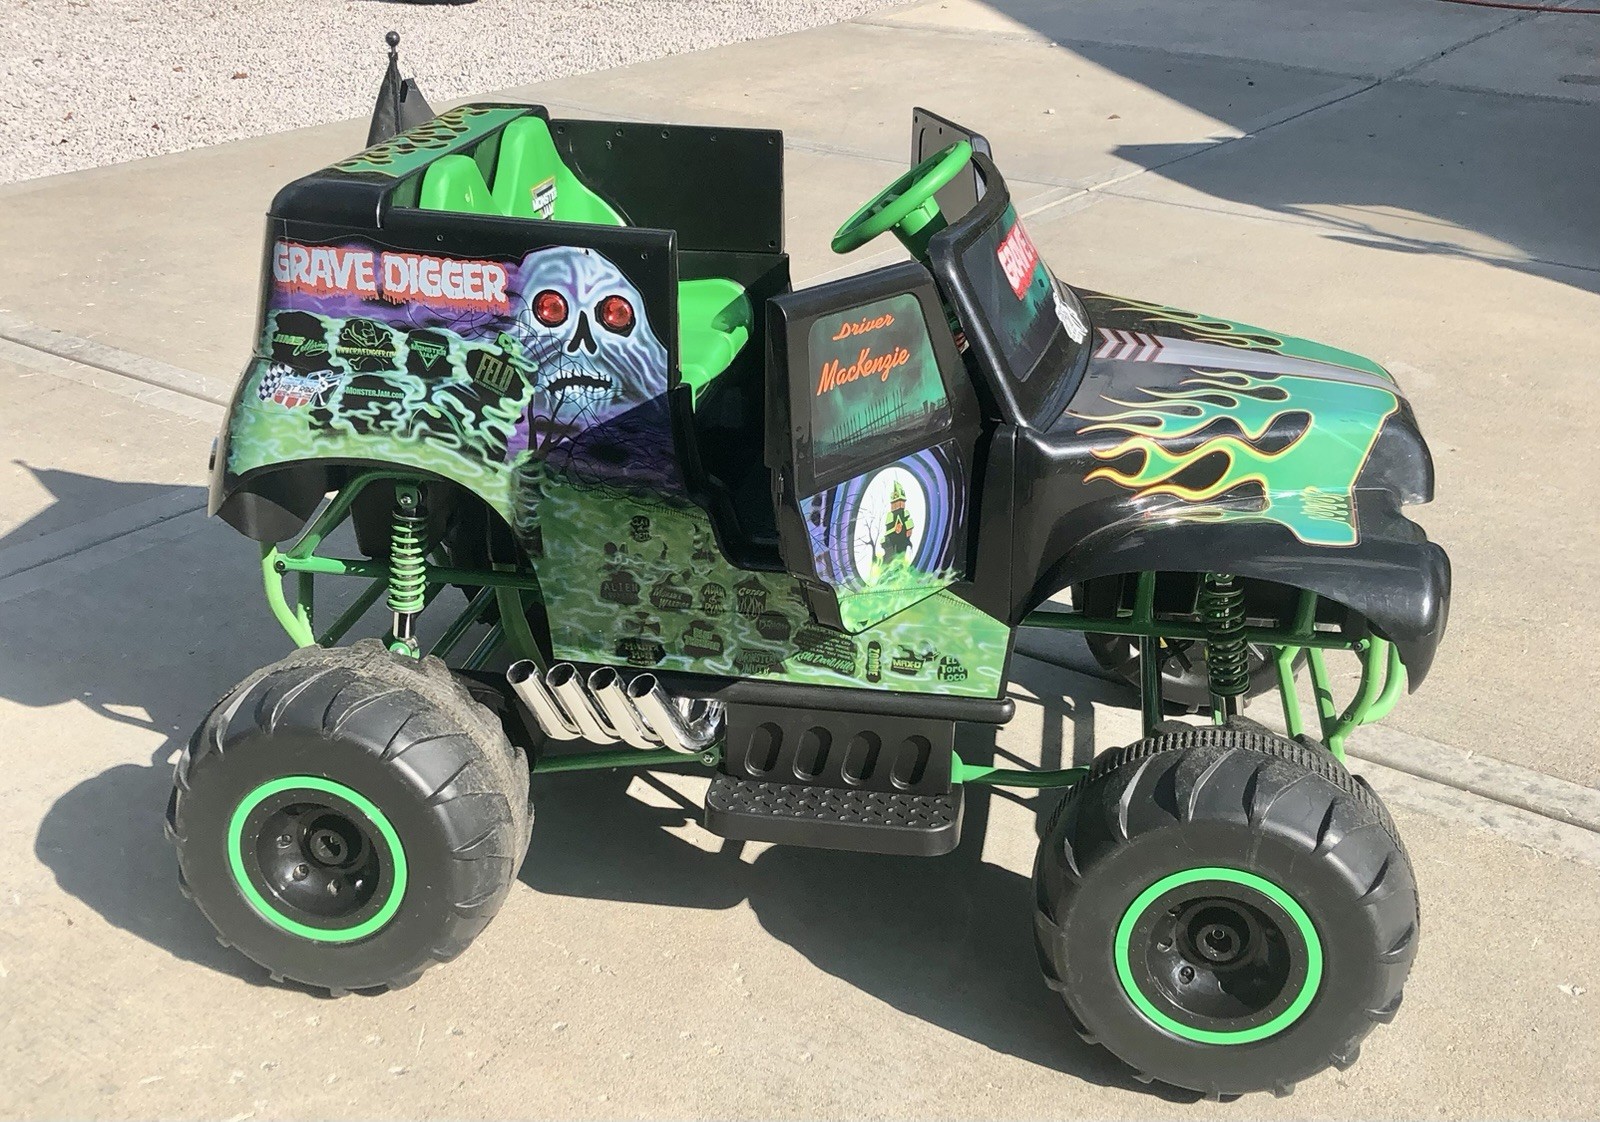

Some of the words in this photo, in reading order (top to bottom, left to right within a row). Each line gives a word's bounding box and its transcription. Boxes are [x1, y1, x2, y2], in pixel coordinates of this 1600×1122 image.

[273, 242, 375, 291] GRAVE
[384, 254, 507, 302] DIGGER
[832, 312, 895, 341] Driver
[474, 353, 514, 393] FELD
[816, 346, 911, 396] MacKenzie
